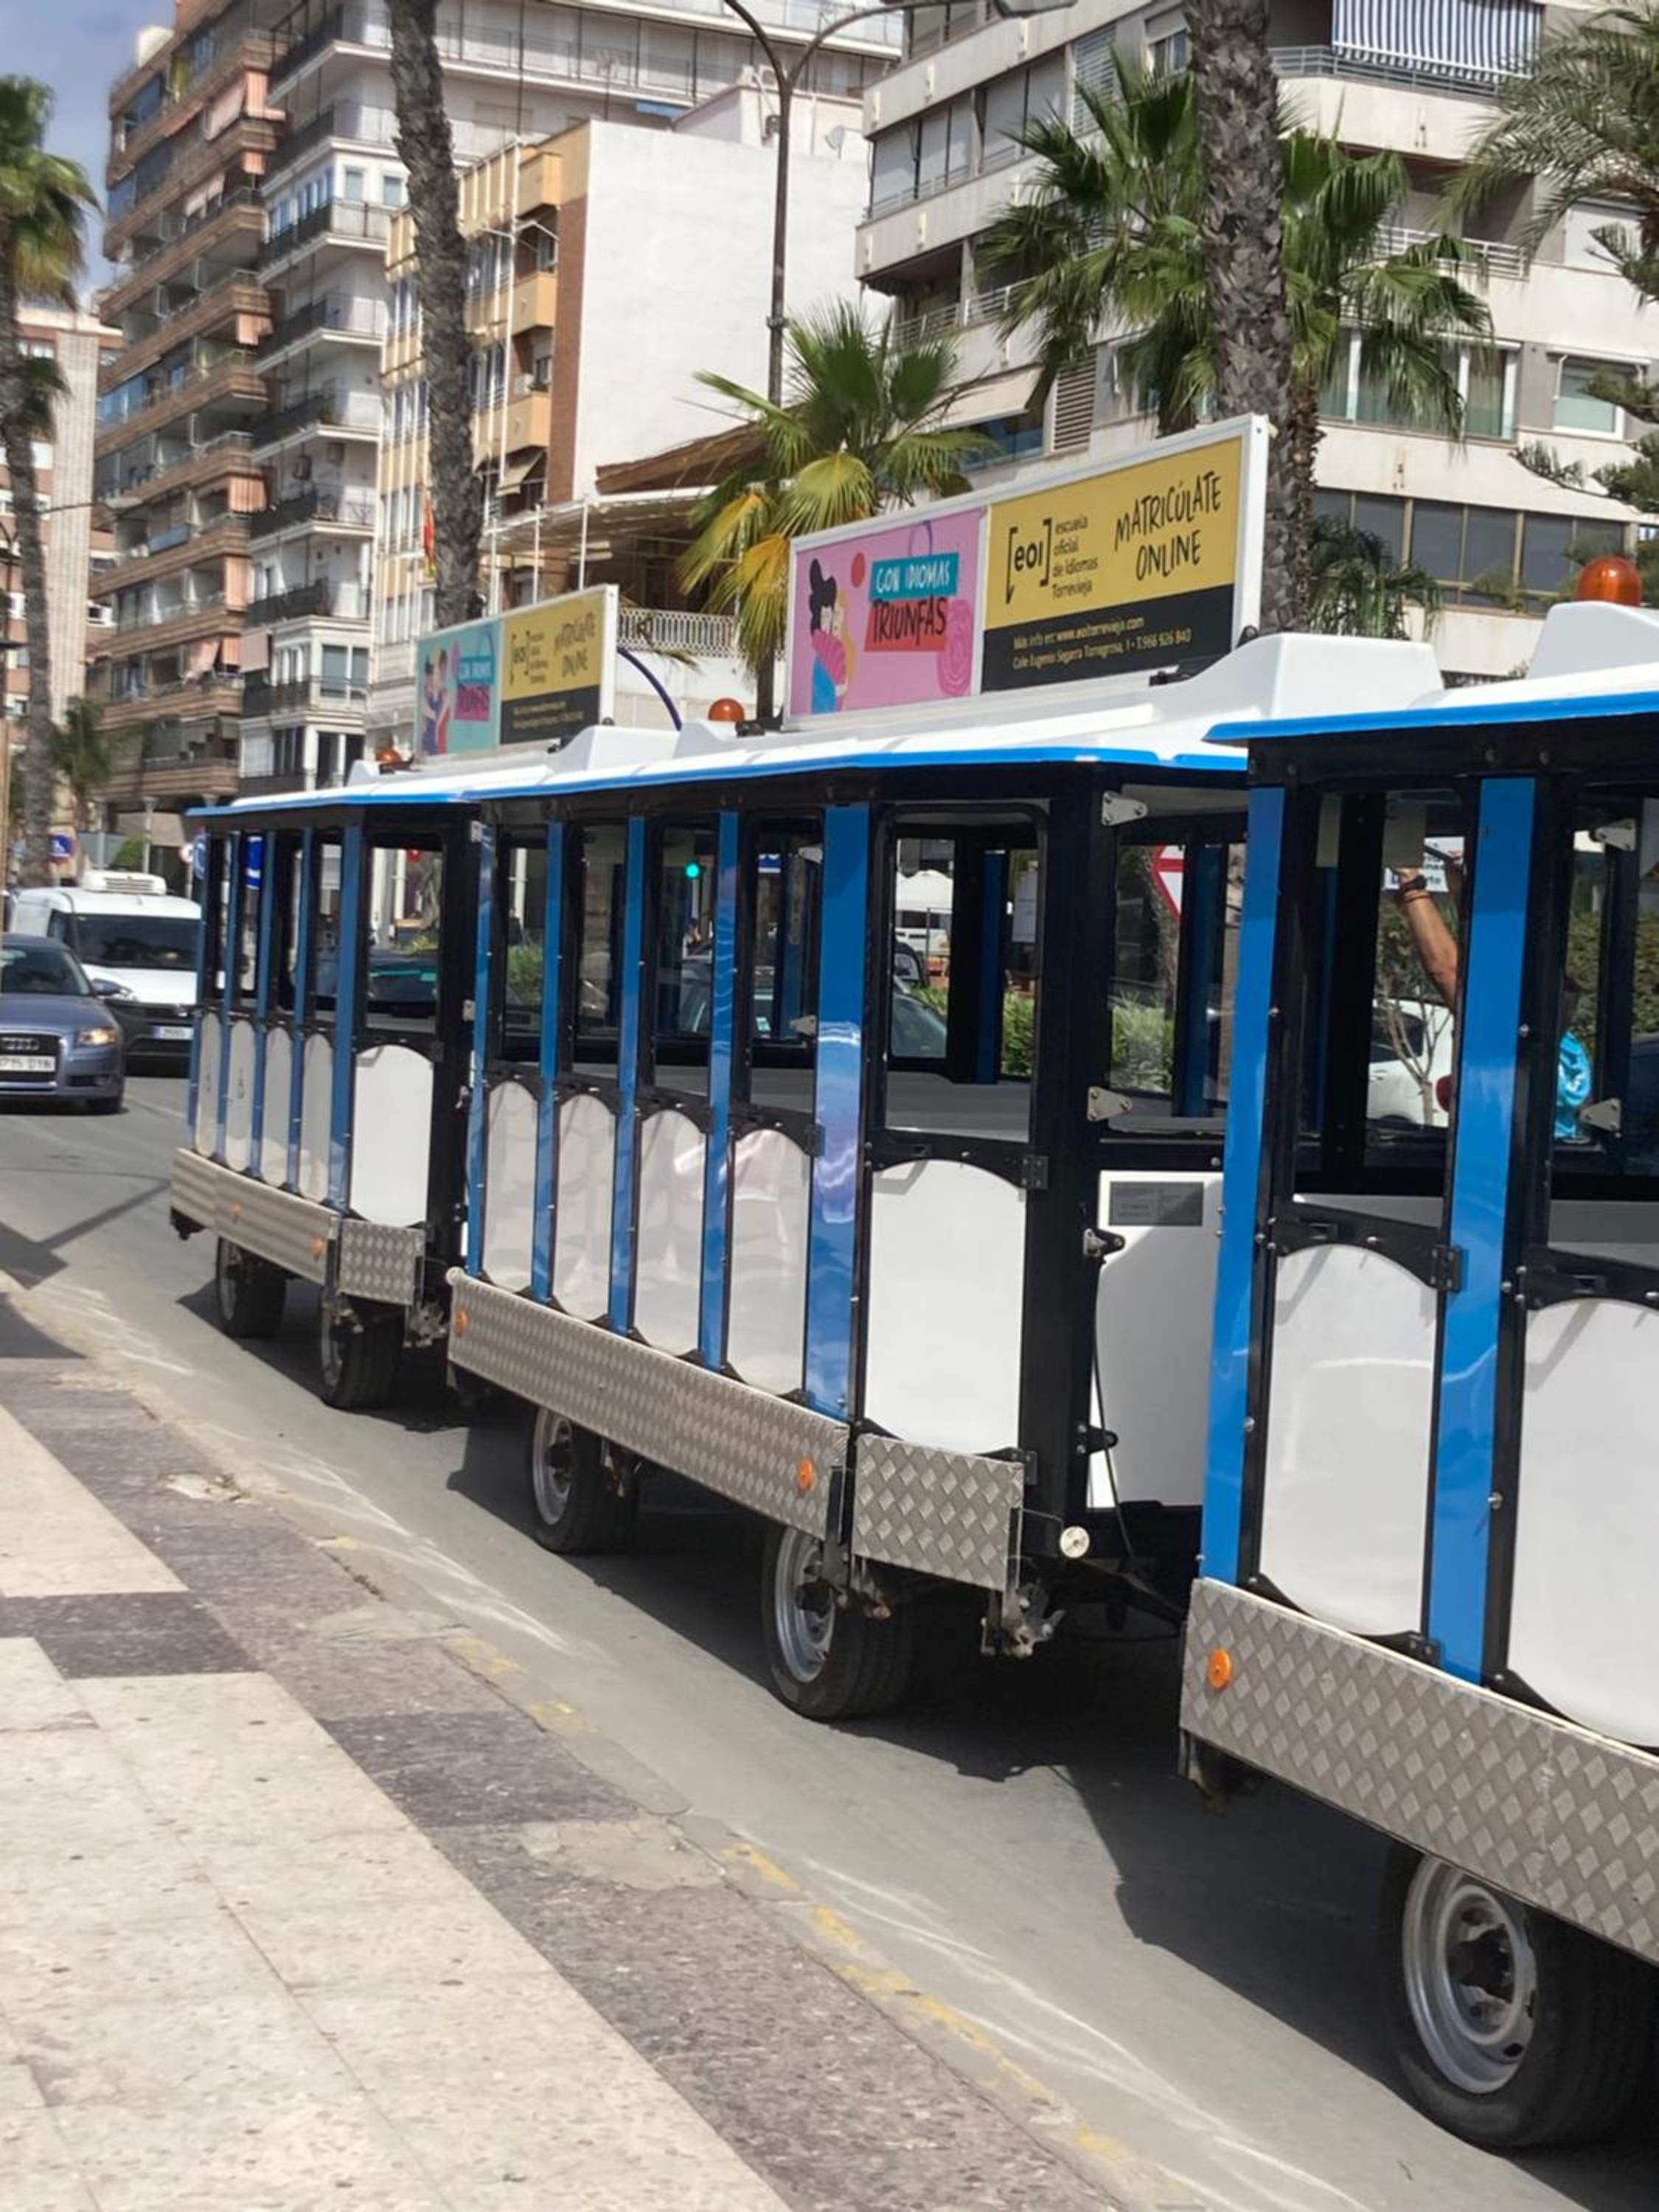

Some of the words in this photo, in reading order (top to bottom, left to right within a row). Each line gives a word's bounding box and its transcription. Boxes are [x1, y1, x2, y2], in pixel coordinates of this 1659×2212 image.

[1115, 470, 1221, 552] MATRICÚLATE
[875, 566, 900, 594] CON
[905, 560, 951, 591] IDIOMAS
[1052, 562, 1064, 578] de
[1136, 529, 1202, 582] ONLINE
[1052, 579, 1093, 599] Torrevieja
[872, 593, 948, 647] TRIUNFAS
